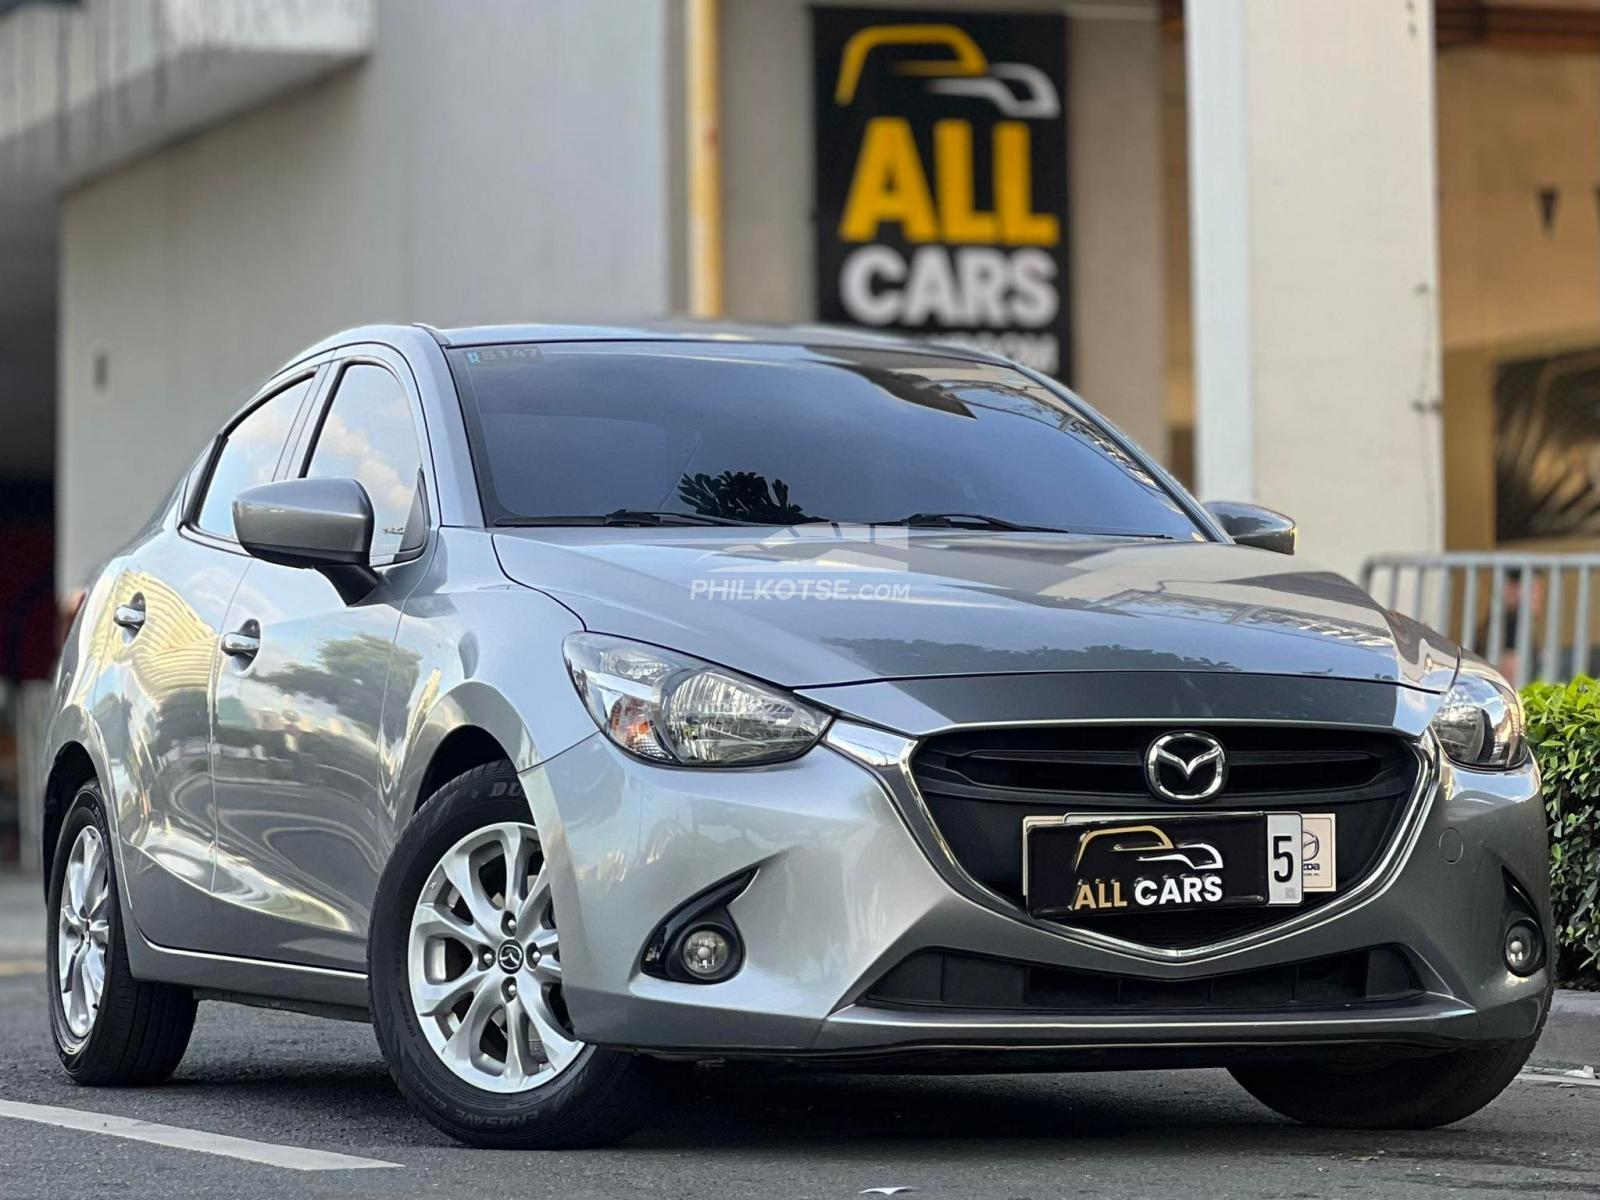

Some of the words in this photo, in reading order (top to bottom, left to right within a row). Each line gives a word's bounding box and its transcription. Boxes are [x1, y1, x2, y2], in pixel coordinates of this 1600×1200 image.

[838, 116, 1060, 246] ALL
[840, 246, 1059, 328] CARS
[1273, 835, 1294, 883] 5
[1073, 881, 1128, 910] ALL
[1134, 875, 1224, 906] CARS
